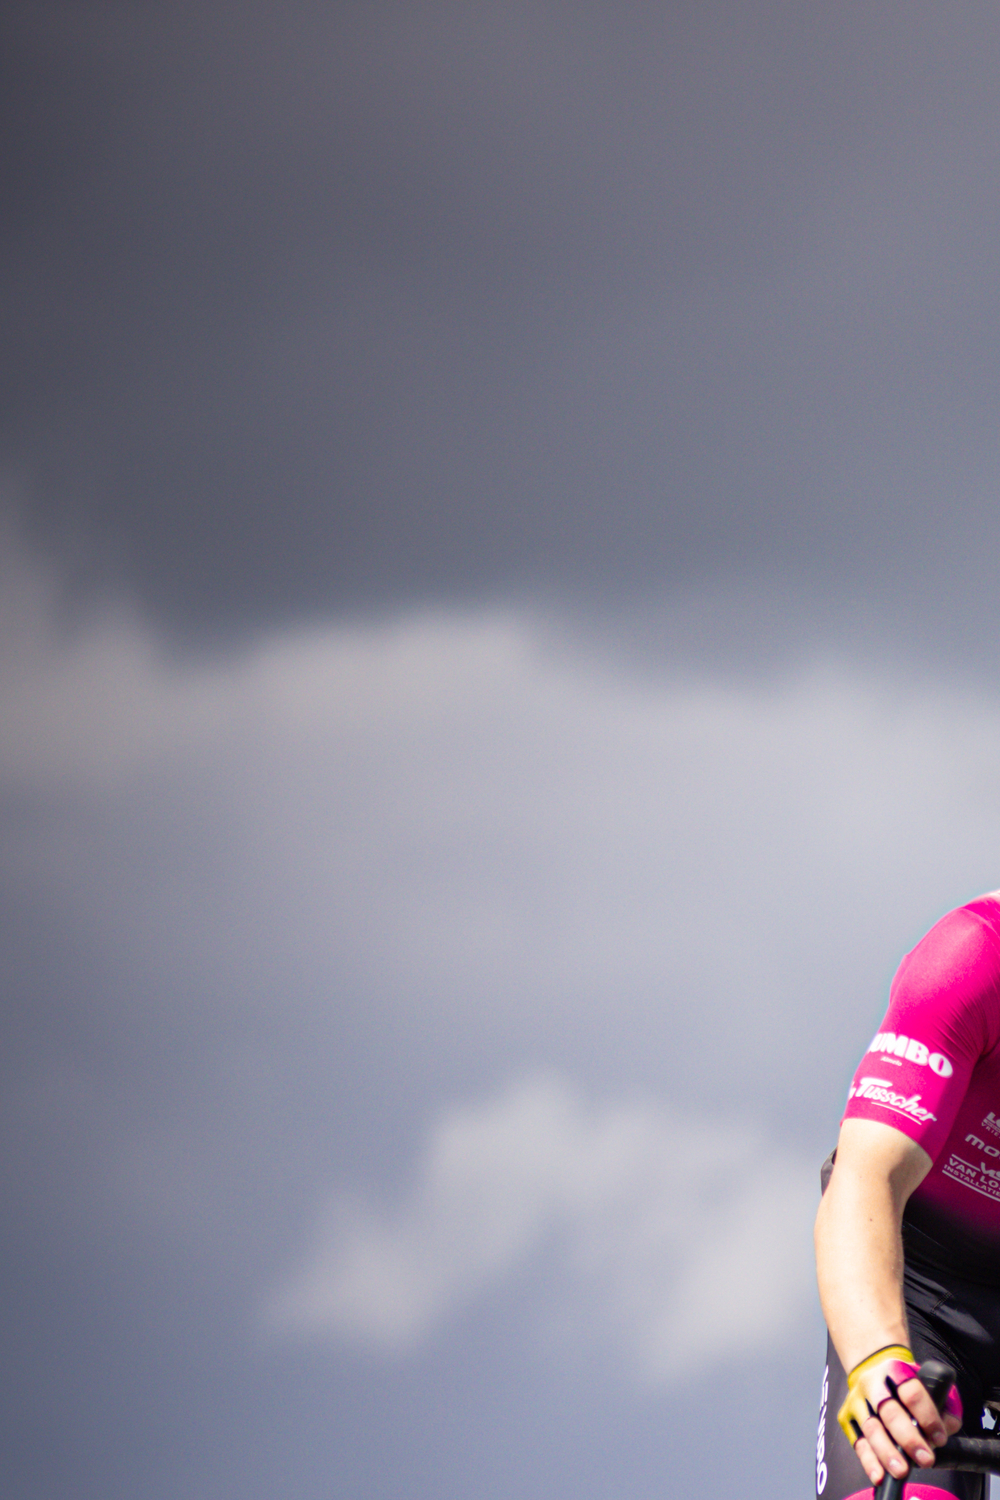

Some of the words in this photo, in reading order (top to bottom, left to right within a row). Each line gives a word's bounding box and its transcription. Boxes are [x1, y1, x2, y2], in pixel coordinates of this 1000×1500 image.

[866, 1033, 953, 1078] UMBO
[855, 1077, 937, 1122] Tusscher
[949, 1157, 977, 1178] VAN
